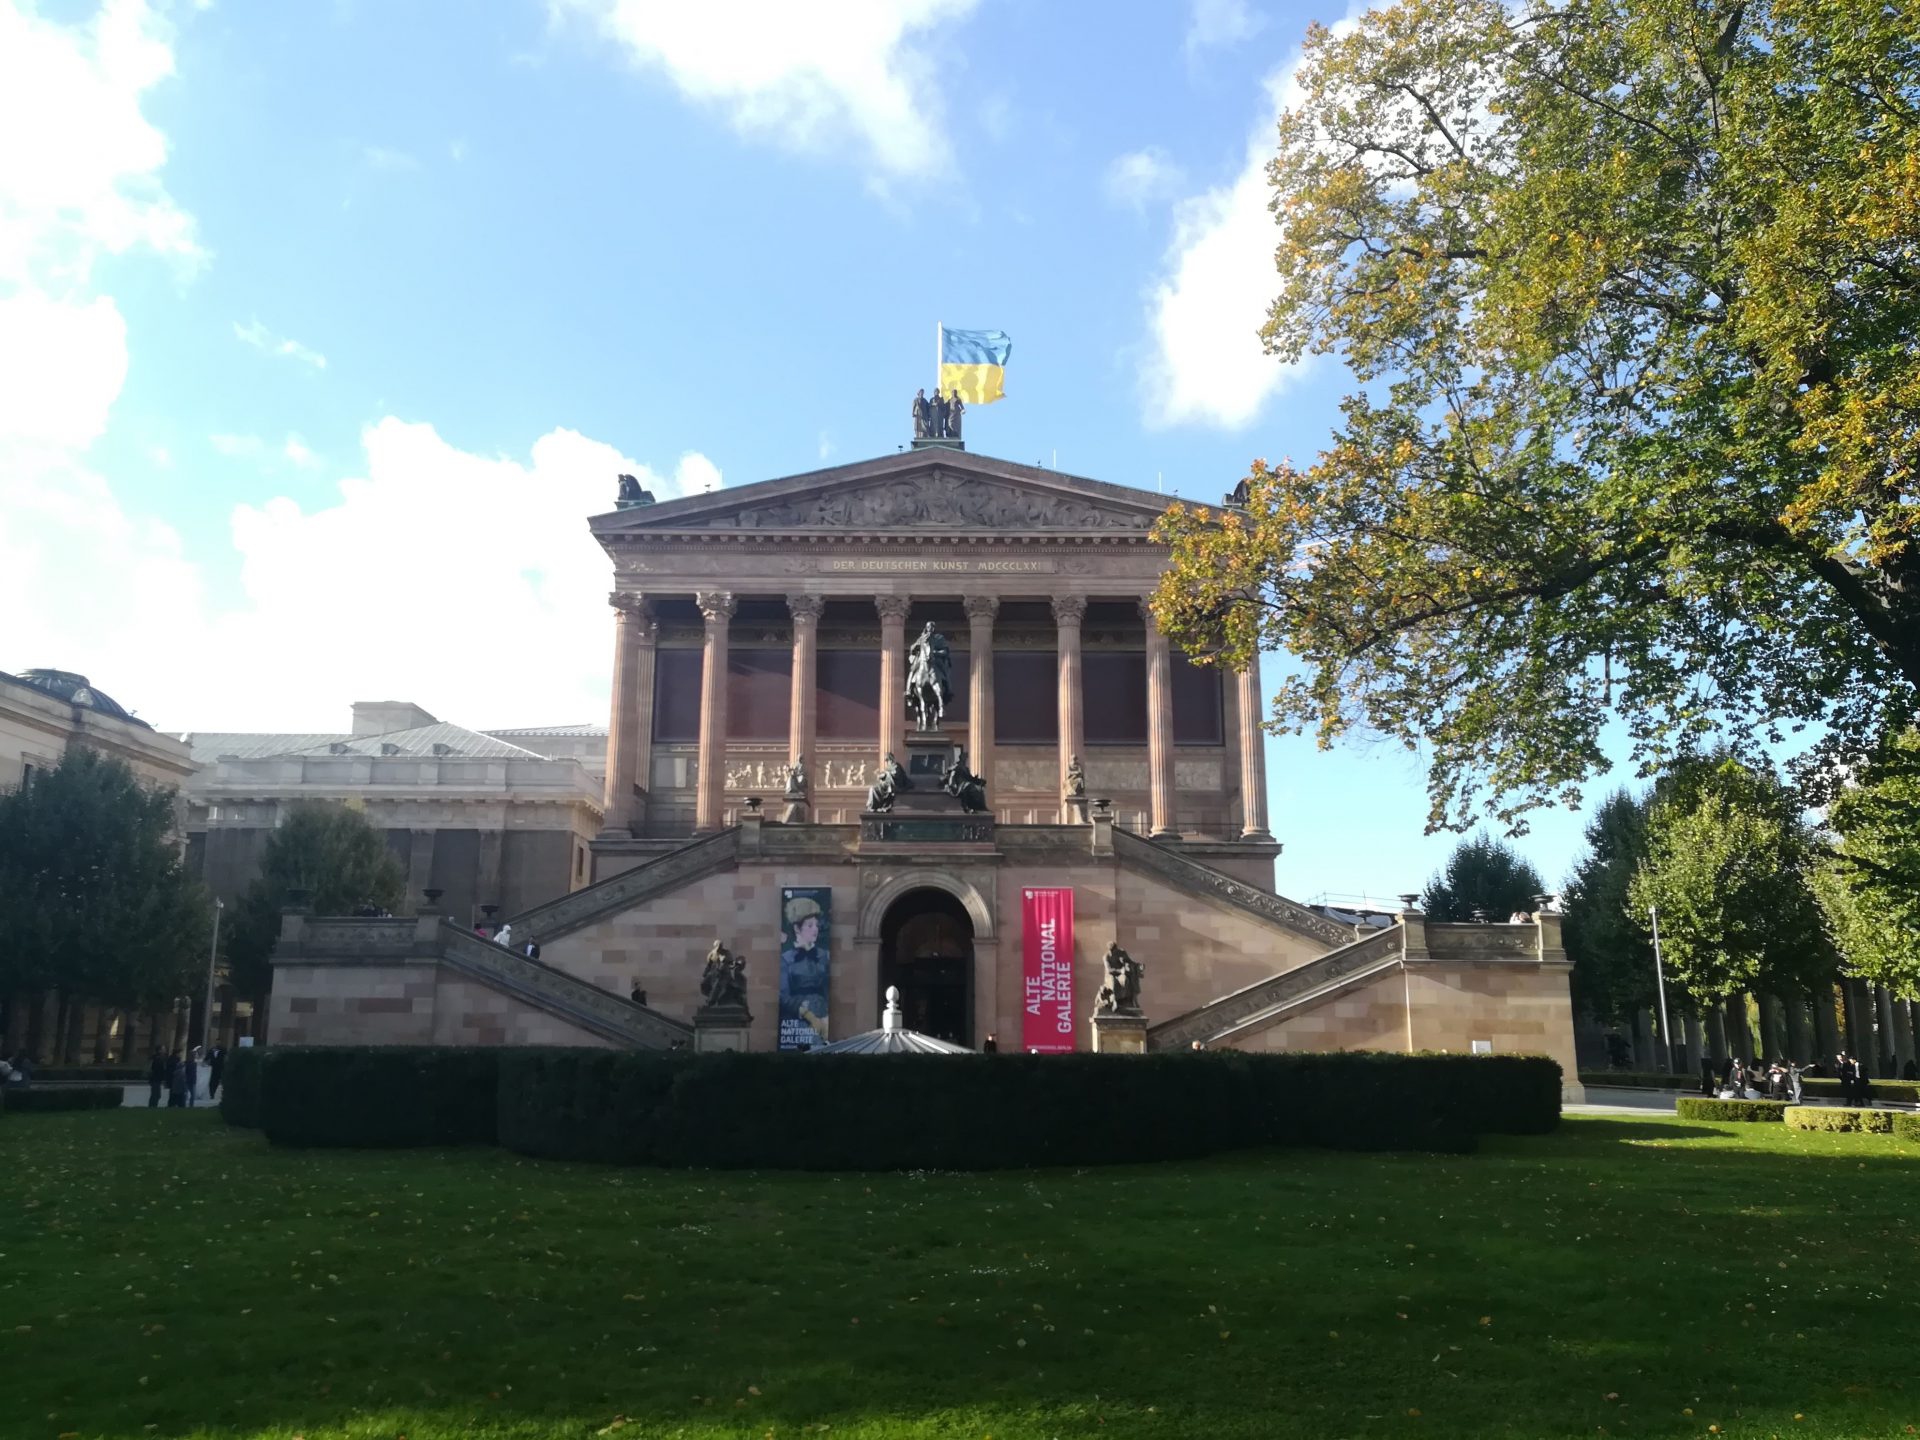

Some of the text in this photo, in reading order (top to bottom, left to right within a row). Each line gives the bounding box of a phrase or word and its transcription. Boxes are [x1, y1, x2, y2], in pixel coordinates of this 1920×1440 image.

[833, 560, 855, 571] DER
[861, 560, 927, 571] DEUTSCHEN
[933, 560, 969, 571] KUNST
[1041, 918, 1056, 1001] NATIONAL
[1026, 976, 1041, 1016] ALTE
[1056, 962, 1072, 1034] GALERIE
[781, 1019, 799, 1028] ALTE
[781, 1027, 818, 1036] NATIONAL
[781, 1035, 814, 1044] GALERIE
